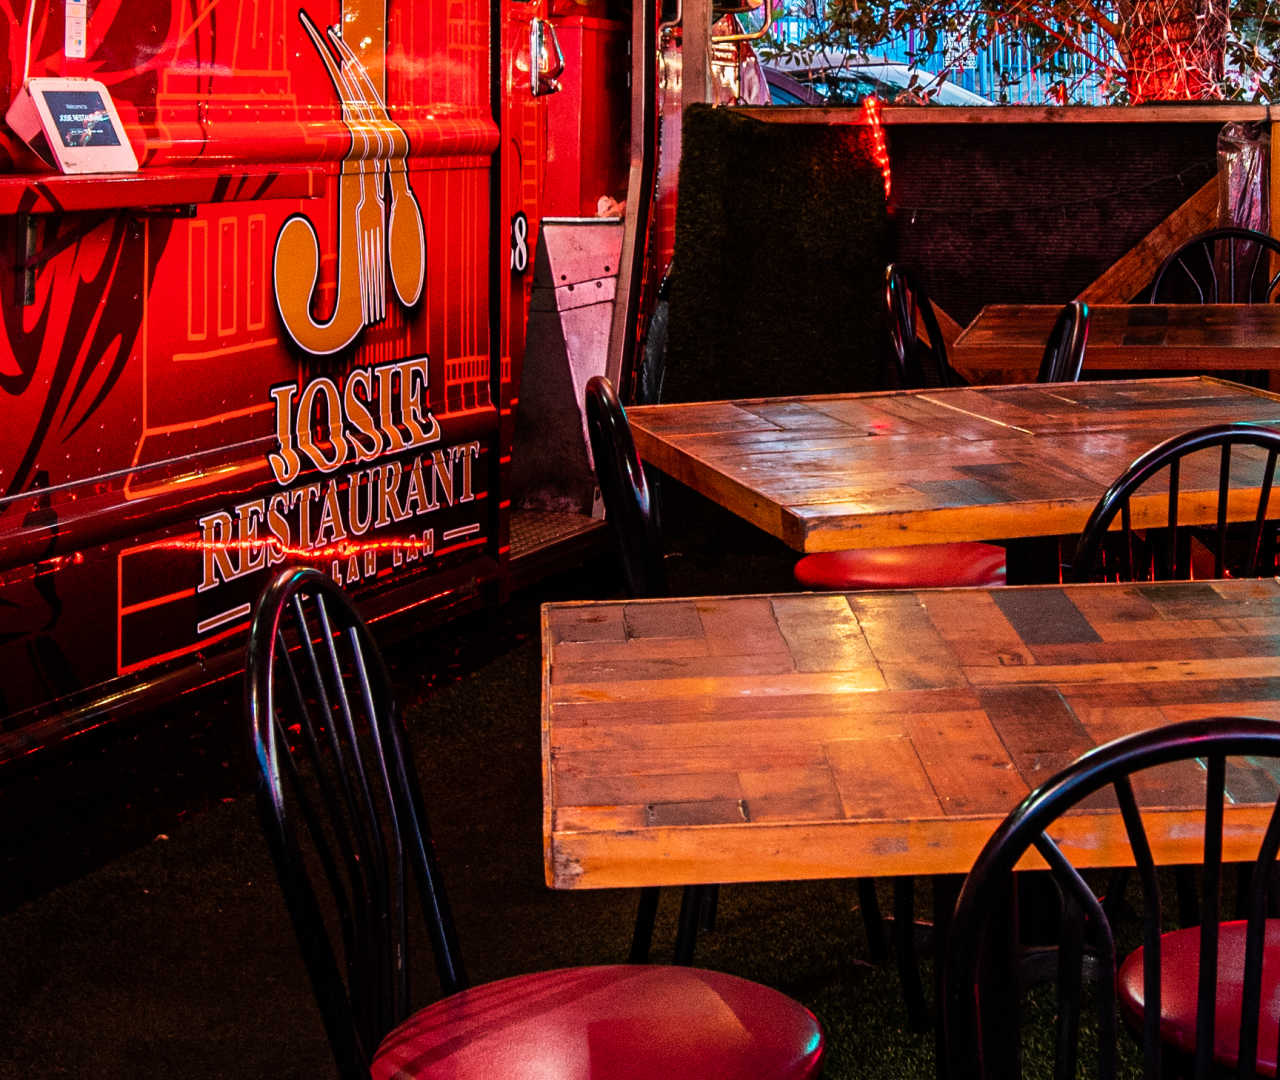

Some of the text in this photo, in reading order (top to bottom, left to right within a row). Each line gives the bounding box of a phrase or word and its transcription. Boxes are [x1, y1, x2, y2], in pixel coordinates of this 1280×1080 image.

[510, 216, 528, 272] 8
[268, 357, 441, 486] JOSIE
[197, 441, 480, 593] RESTAURANT
[332, 528, 435, 587] LAH LAH
